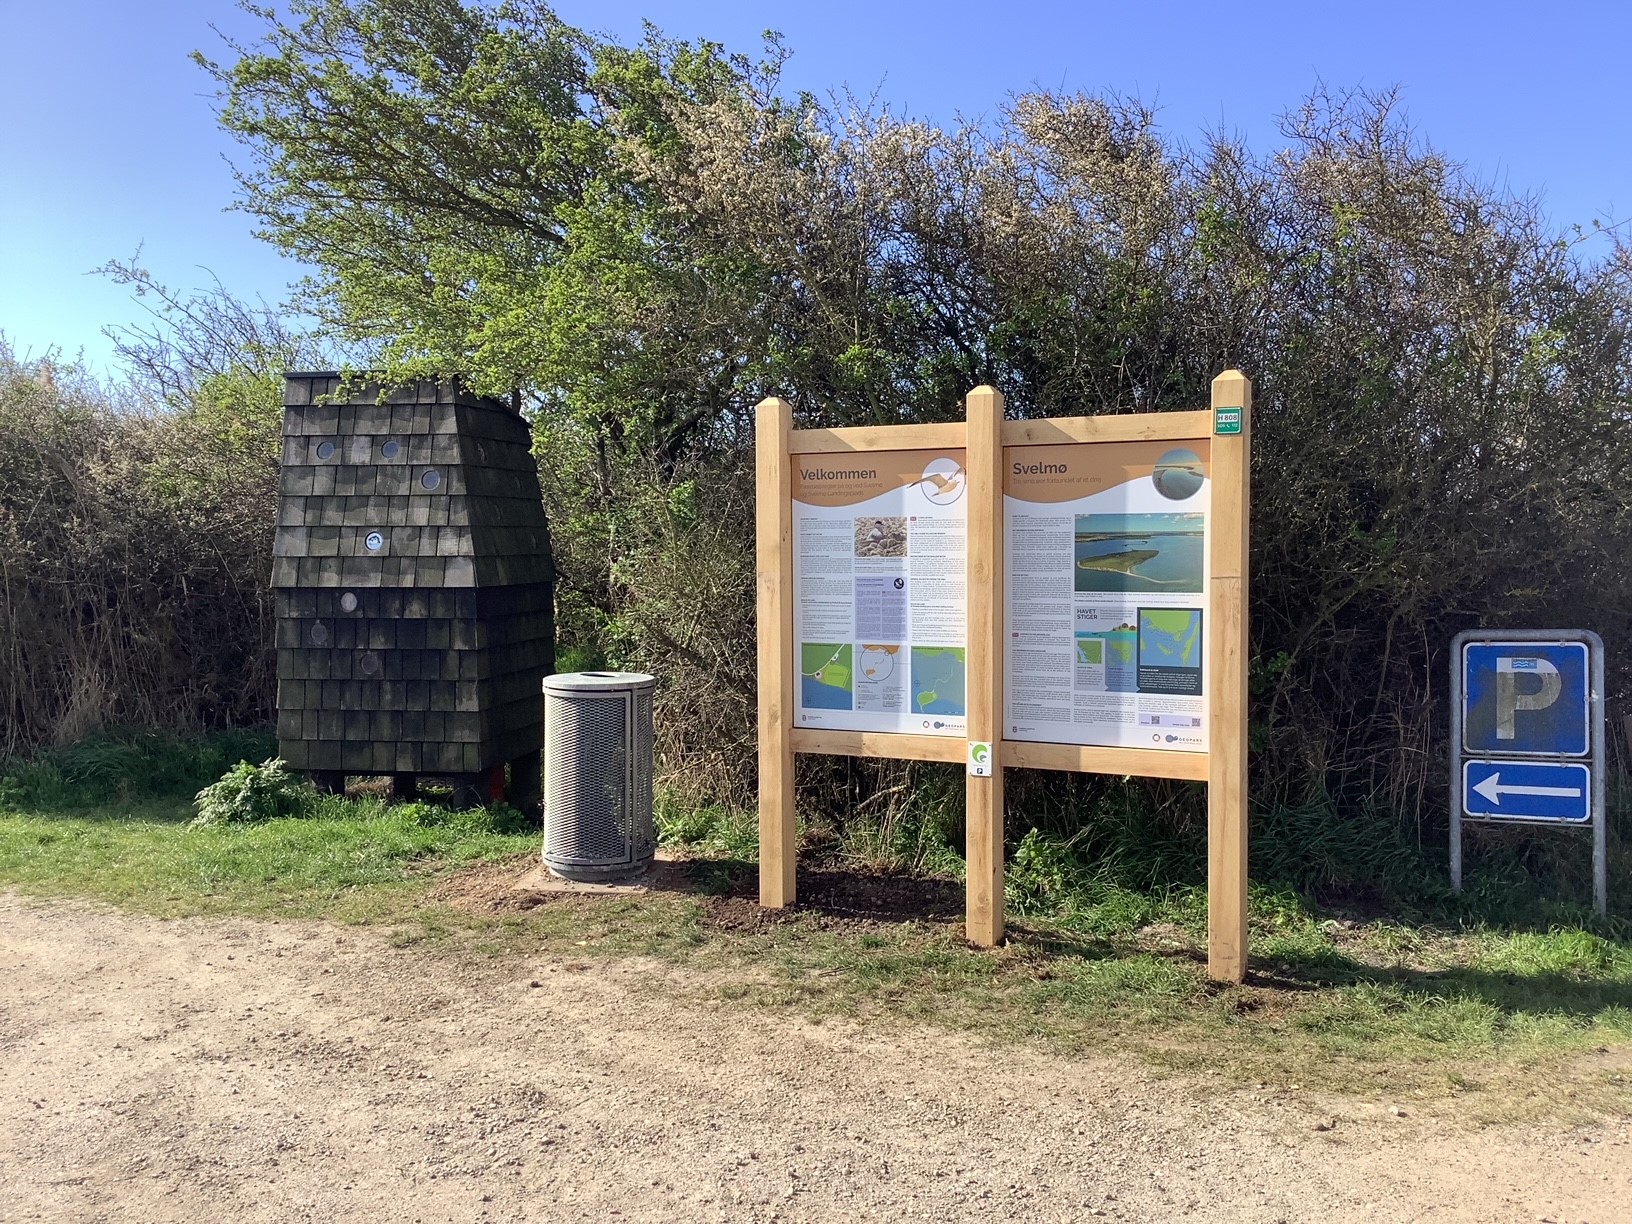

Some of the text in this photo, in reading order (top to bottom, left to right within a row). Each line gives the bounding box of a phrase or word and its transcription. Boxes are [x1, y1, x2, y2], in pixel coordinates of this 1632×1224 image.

[800, 468, 876, 480] Velkommen
[1013, 461, 1067, 474] Svelmø
[1497, 657, 1562, 739] P
